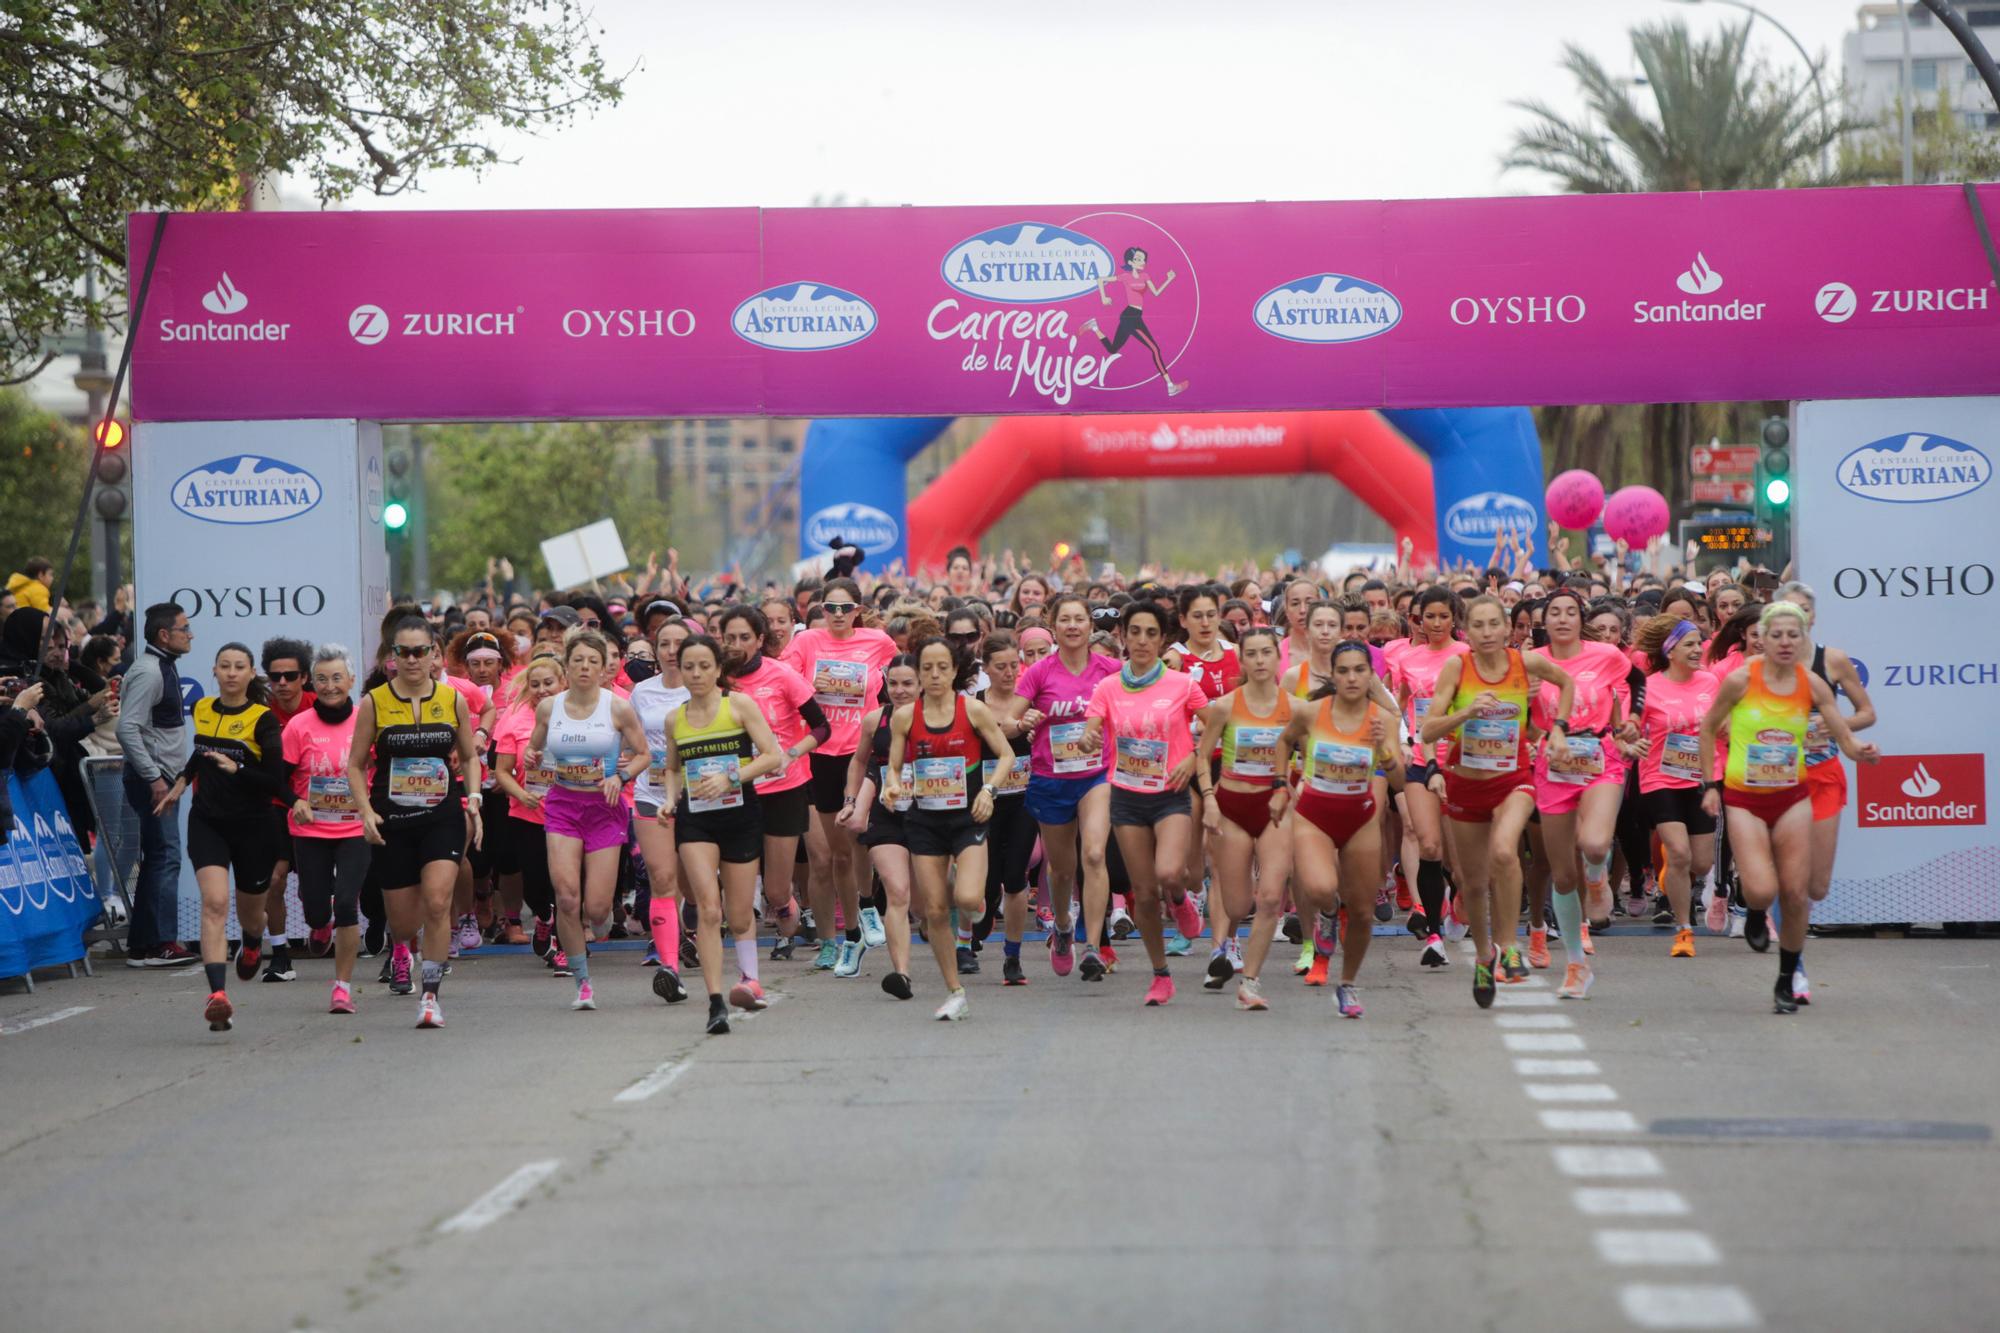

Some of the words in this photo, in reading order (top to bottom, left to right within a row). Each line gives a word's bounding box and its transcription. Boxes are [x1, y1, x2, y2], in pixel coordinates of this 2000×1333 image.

[955, 253, 1100, 282] ASTURIANA
[1450, 295, 1586, 325] OYSHO
[1634, 299, 1766, 323] Santander
[1871, 288, 1988, 312] ZURICH
[402, 312, 515, 336] ZURICH
[562, 308, 696, 337] OYSHO
[743, 307, 866, 333] ASTURIANA
[927, 298, 1069, 341] Carrera
[1265, 300, 1390, 325] ASTURIANA
[160, 319, 290, 341] Santander
[961, 342, 989, 371] de
[993, 340, 1013, 371] la
[1008, 335, 1122, 405] Mujer
[1177, 424, 1286, 449] Santander
[1848, 459, 1981, 486] ASTURIANA
[182, 481, 312, 507] ASTURIANA
[1833, 564, 1994, 599] OYSHO
[170, 584, 326, 619] OYSHO
[1885, 663, 1998, 687] ZURICH
[561, 733, 587, 743] Delta
[1478, 740, 1502, 749] 016
[1128, 757, 1149, 768] 016
[1252, 747, 1275, 756] 016
[1678, 751, 1698, 762] 016
[407, 775, 432, 787] 016
[567, 765, 588, 775] 016
[1330, 764, 1353, 774] 016
[1762, 764, 1784, 775] 016
[926, 778, 950, 788] 016
[325, 794, 347, 804] 016
[1866, 800, 1977, 821] Santander
